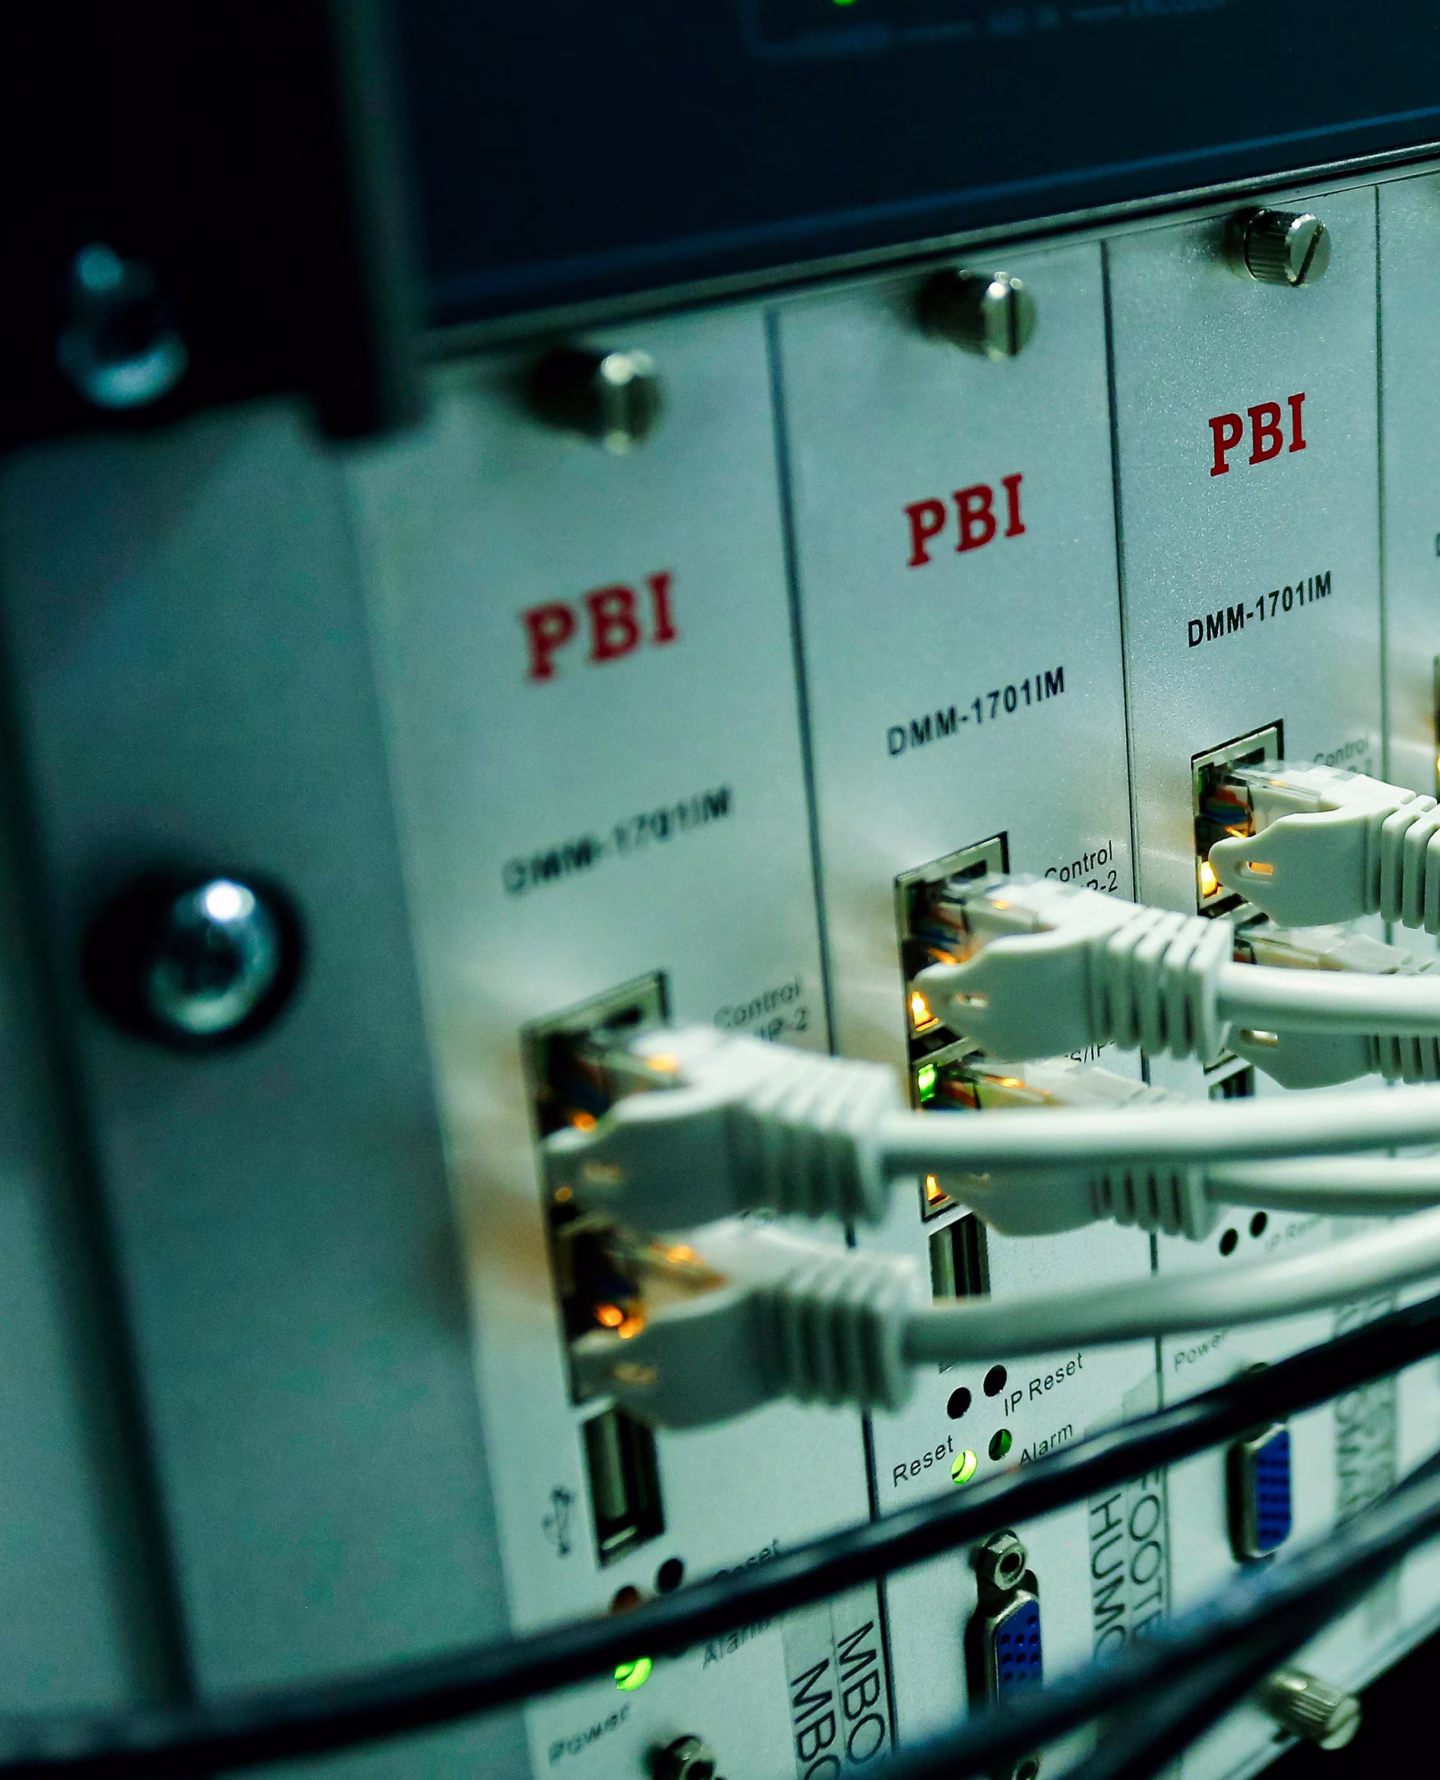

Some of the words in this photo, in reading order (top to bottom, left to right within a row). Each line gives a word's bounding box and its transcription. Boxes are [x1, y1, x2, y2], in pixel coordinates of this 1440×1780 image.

[1209, 393, 1307, 476] PBI
[905, 473, 1026, 566] PBI
[521, 570, 679, 683] PBI
[1187, 570, 1333, 648] DMM-1701IM
[887, 666, 1066, 755] DMM-1701IM
[1003, 1390, 1024, 1418] IP
[1028, 1352, 1083, 1402] Reset
[892, 1434, 955, 1489] Reset
[1019, 1423, 1075, 1468] Alarm
